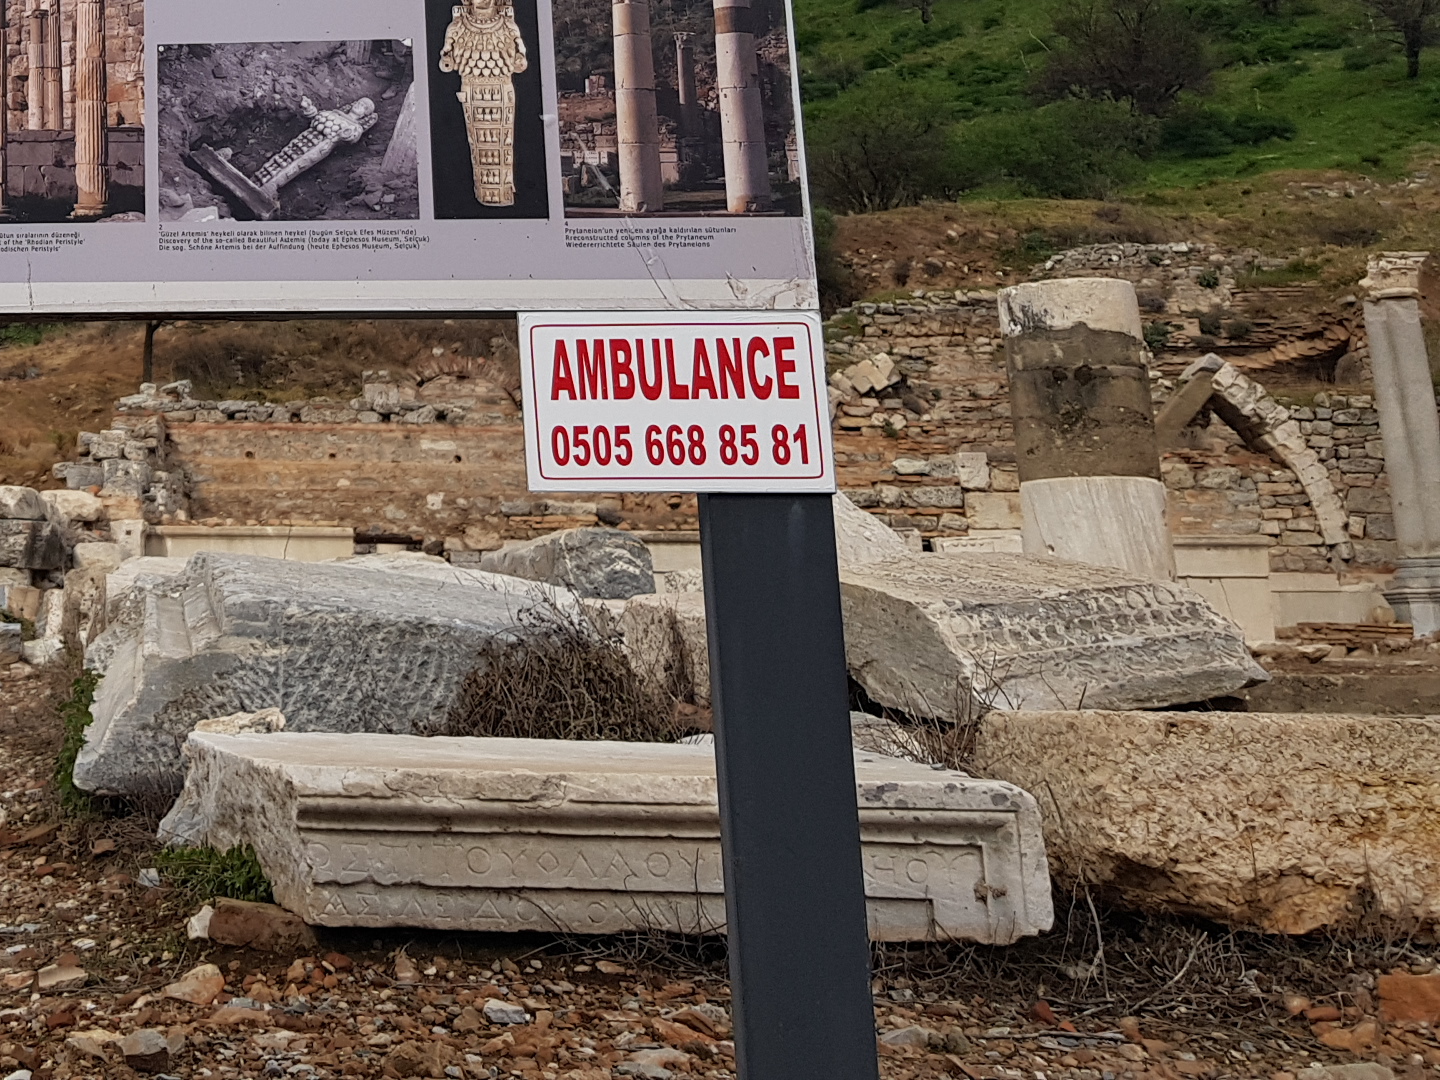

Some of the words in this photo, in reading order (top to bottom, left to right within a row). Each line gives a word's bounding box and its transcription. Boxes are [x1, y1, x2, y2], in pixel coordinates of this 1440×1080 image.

[551, 337, 800, 400] AMBULANCE
[552, 425, 633, 466] 0505
[645, 424, 706, 466] 668
[719, 424, 759, 466] 85
[772, 424, 808, 465] 81
